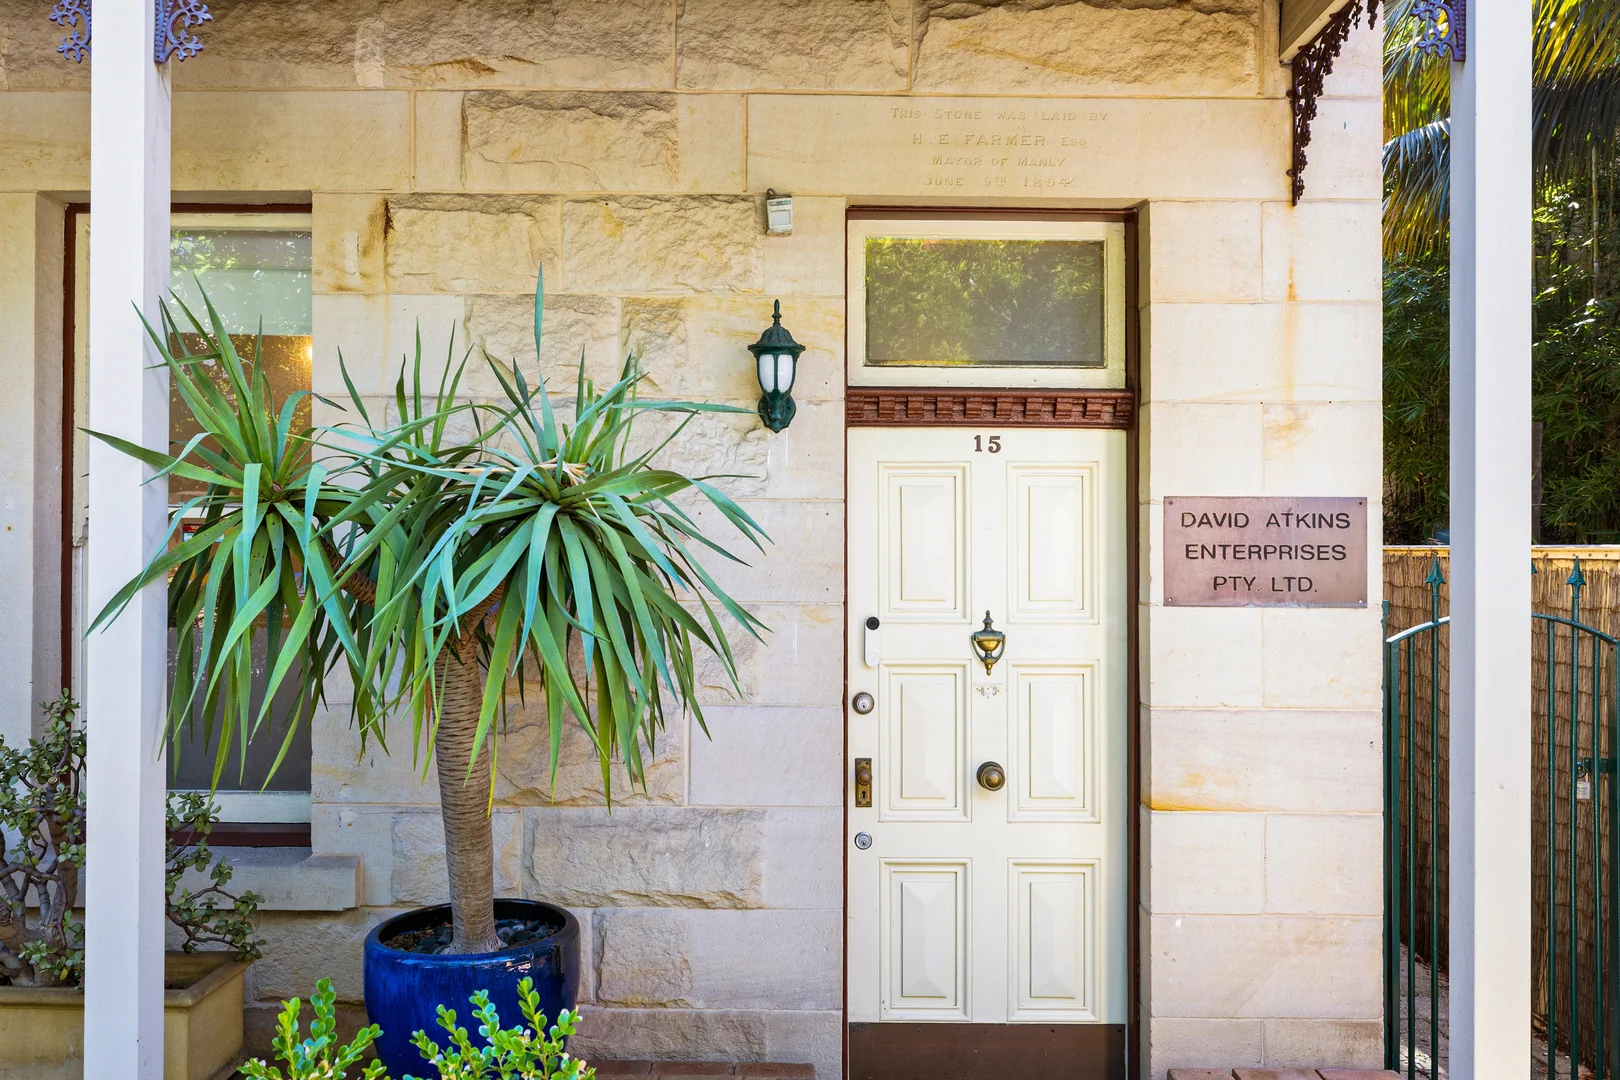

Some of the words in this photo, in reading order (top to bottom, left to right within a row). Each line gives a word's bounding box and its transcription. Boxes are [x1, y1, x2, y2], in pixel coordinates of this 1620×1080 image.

[933, 109, 982, 120] STONE
[997, 111, 1027, 121] WAS
[1041, 112, 1077, 121] LAID
[1088, 112, 1109, 121] BY
[964, 133, 1046, 146] FARMER
[932, 154, 983, 166] MAYOR
[991, 157, 1009, 167] OF
[923, 176, 964, 187] JUNE
[974, 434, 1002, 454] 15
[1181, 512, 1250, 529] DAVID
[1265, 512, 1351, 529] ATKINS
[1185, 544, 1347, 561] ENTERPRISES
[1213, 576, 1260, 592] PTY.
[1271, 576, 1318, 593] LTD.
